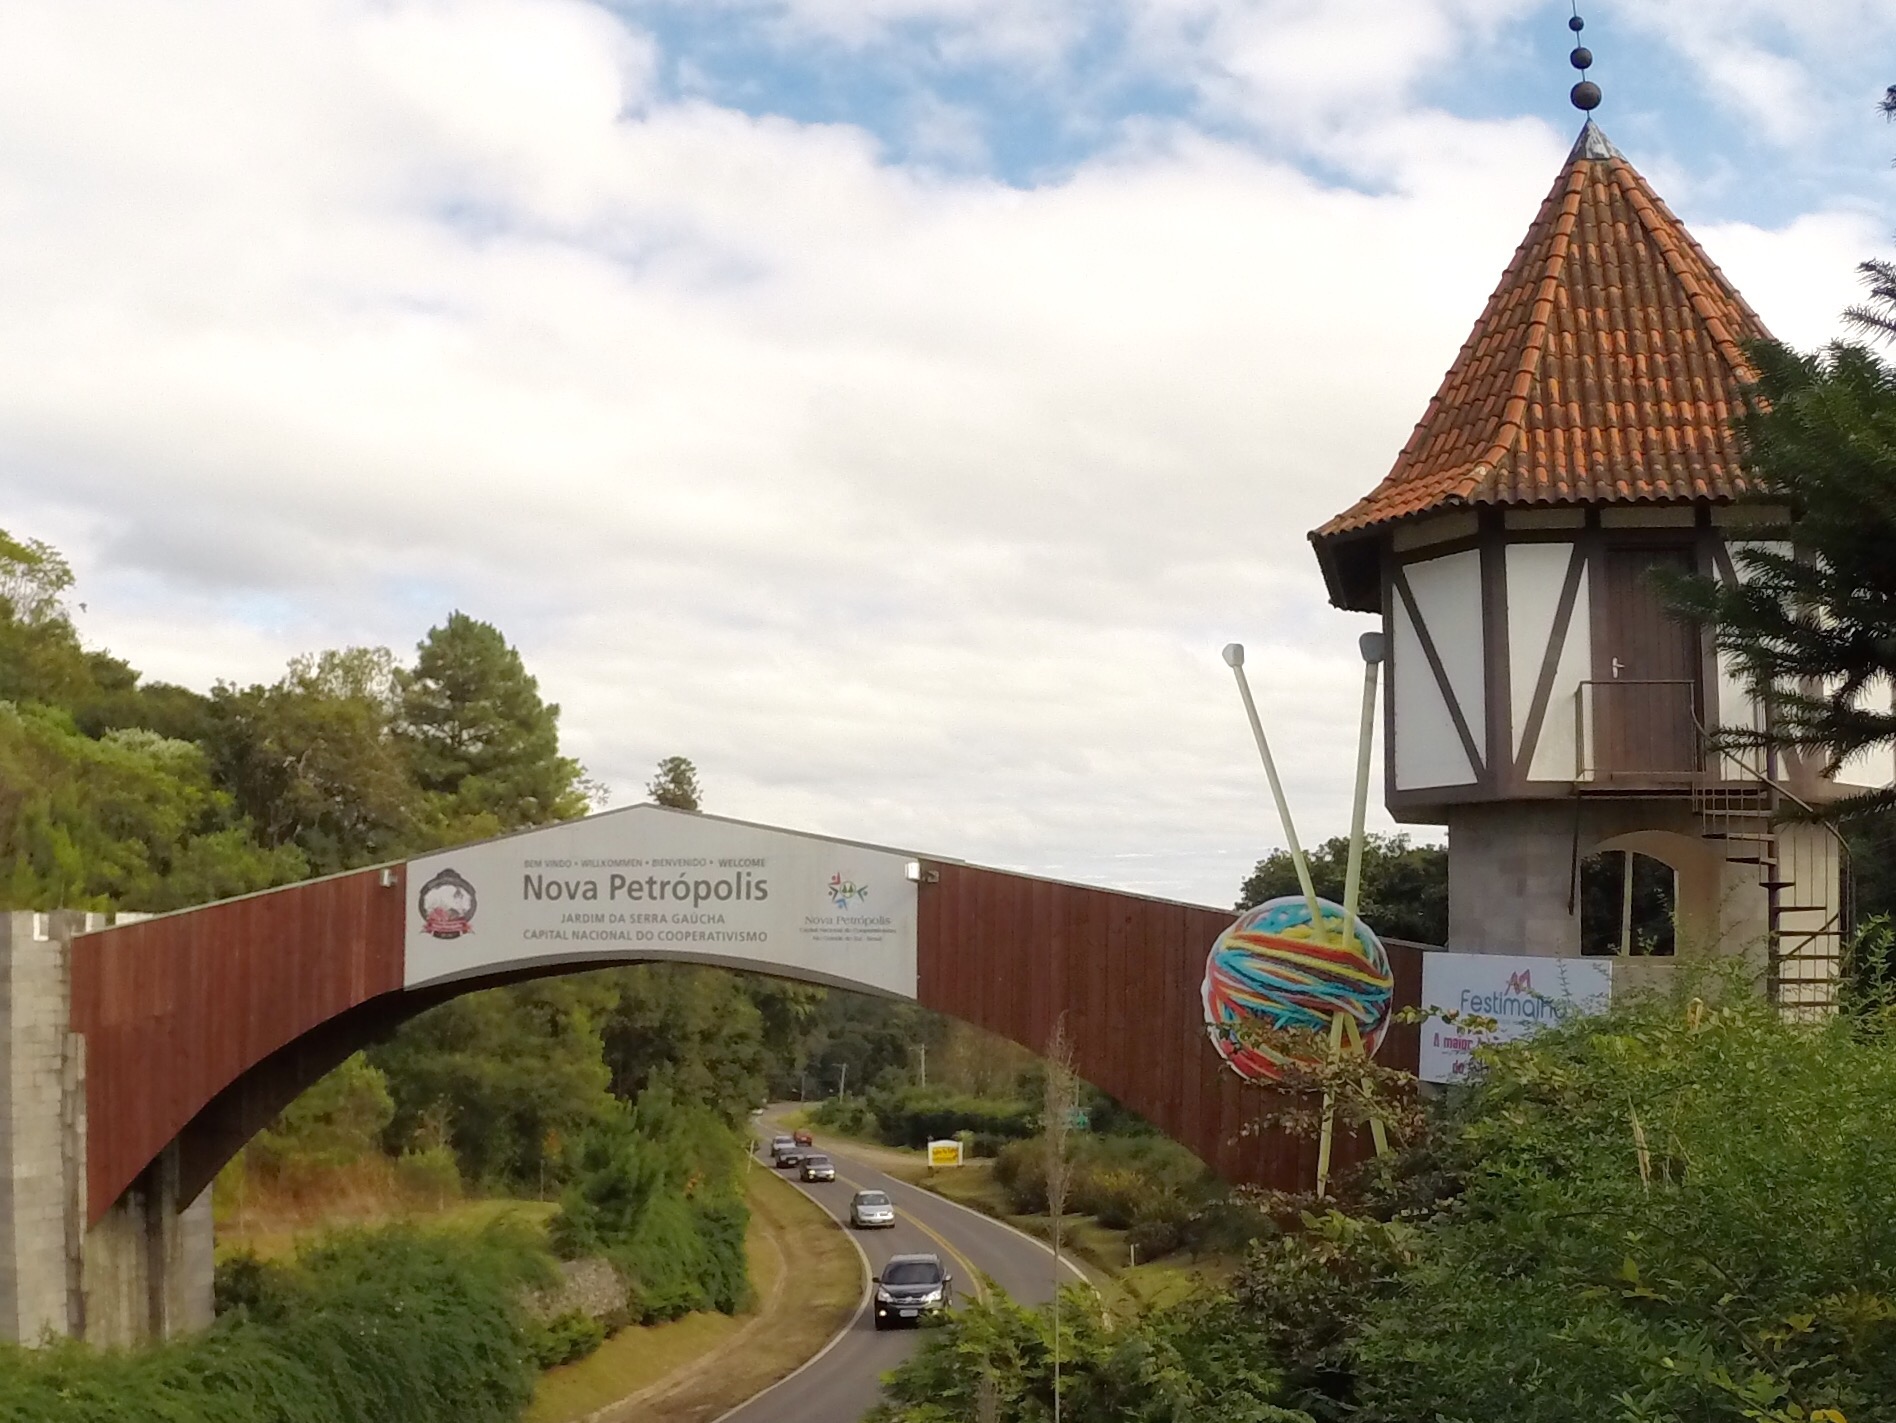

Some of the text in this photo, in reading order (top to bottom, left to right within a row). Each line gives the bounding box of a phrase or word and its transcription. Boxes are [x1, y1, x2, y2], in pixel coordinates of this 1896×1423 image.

[718, 857, 765, 868] WELCOME
[523, 871, 768, 908] Nova Petrópolis
[561, 910, 725, 925] JARDIM DA SERRA GAÚCHA
[805, 914, 892, 926] Nova Petrópolis
[523, 929, 768, 942] CAPITAL NACIONAL DO COOPERATIVISMO
[1433, 1032, 1440, 1048] A
[1443, 1036, 1473, 1051] maior
